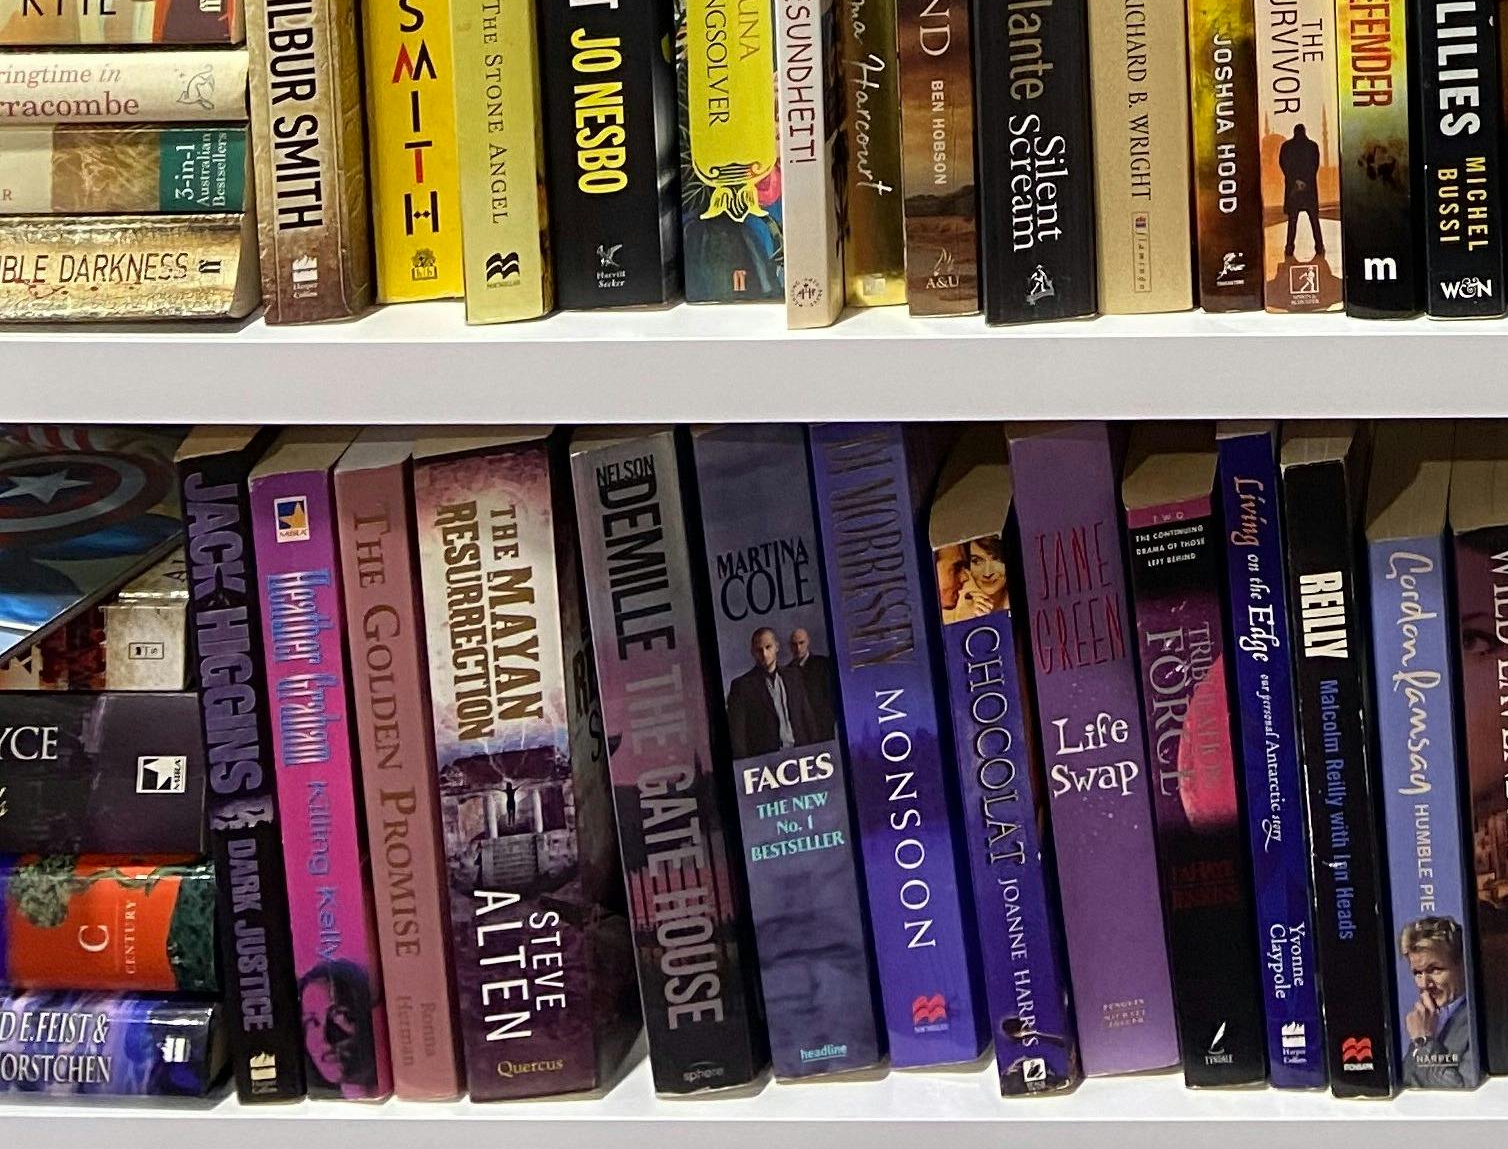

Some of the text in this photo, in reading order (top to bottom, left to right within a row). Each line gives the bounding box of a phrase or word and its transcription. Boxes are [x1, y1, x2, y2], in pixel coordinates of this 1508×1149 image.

[1212, 35, 1237, 214] JOSHUA HOOD
[1435, 1, 1481, 137] LILIES
[271, 114, 324, 231] SMITH
[484, 54, 510, 224] STONE ANGEL
[1008, 114, 1041, 252] Scream
[1034, 135, 1069, 242] Silent
[1437, 168, 1459, 244] BUSSI
[1464, 156, 1489, 251] MICHEL
[182, 473, 263, 794] JACK HIGGINS
[435, 500, 496, 741] RESURRECTION
[487, 566, 545, 722] MAYAN
[1299, 571, 1349, 659] REILLY
[363, 605, 420, 958] GOLDEN PROMISE
[743, 753, 836, 796] FACES
[1051, 712, 1129, 756] Life
[1051, 760, 1139, 797] Swap
[751, 830, 845, 862] BESTSELLER
[874, 689, 936, 950] MONSOON
[1415, 804, 1435, 912] HUMBLE PIE
[228, 838, 273, 1032] DARK JUSTICE
[473, 890, 532, 1043] ALTEN
[529, 911, 566, 1013] STEVE
[997, 878, 1027, 961] JOANNE
